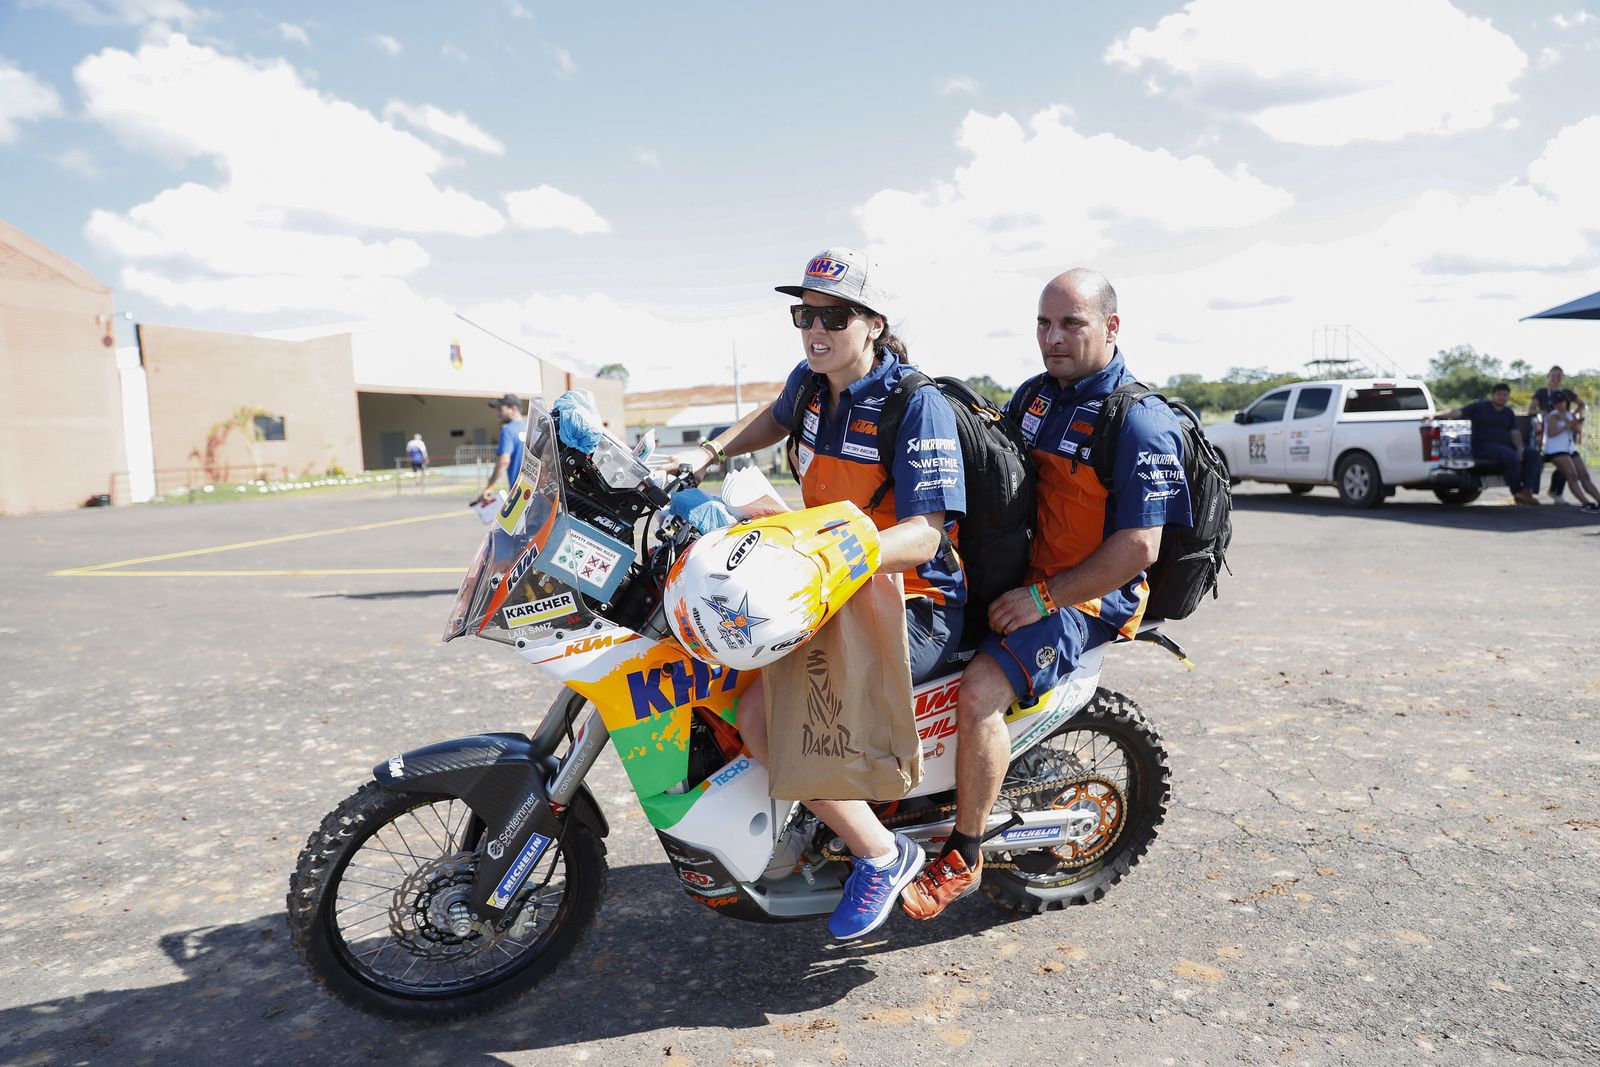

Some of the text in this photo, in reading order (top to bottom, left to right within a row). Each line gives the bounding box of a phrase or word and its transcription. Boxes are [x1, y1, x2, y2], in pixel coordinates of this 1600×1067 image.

[809, 258, 846, 278] KH-7
[850, 419, 878, 436] KTM
[1249, 442, 1267, 459] E22
[593, 515, 622, 533] KTM
[729, 535, 758, 567] HJC
[507, 545, 539, 592] KTM
[505, 595, 571, 619] KÄRCHER
[507, 621, 554, 639] LAIA SANZ
[564, 635, 612, 657] KTM
[914, 679, 960, 718] TM
[918, 716, 958, 740] ally
[802, 723, 860, 759] DAKAR
[711, 758, 749, 788] TECHO
[499, 792, 537, 843] Schlemmer
[1006, 827, 1060, 841] MICHELIN
[503, 837, 542, 893] MICHELIN
